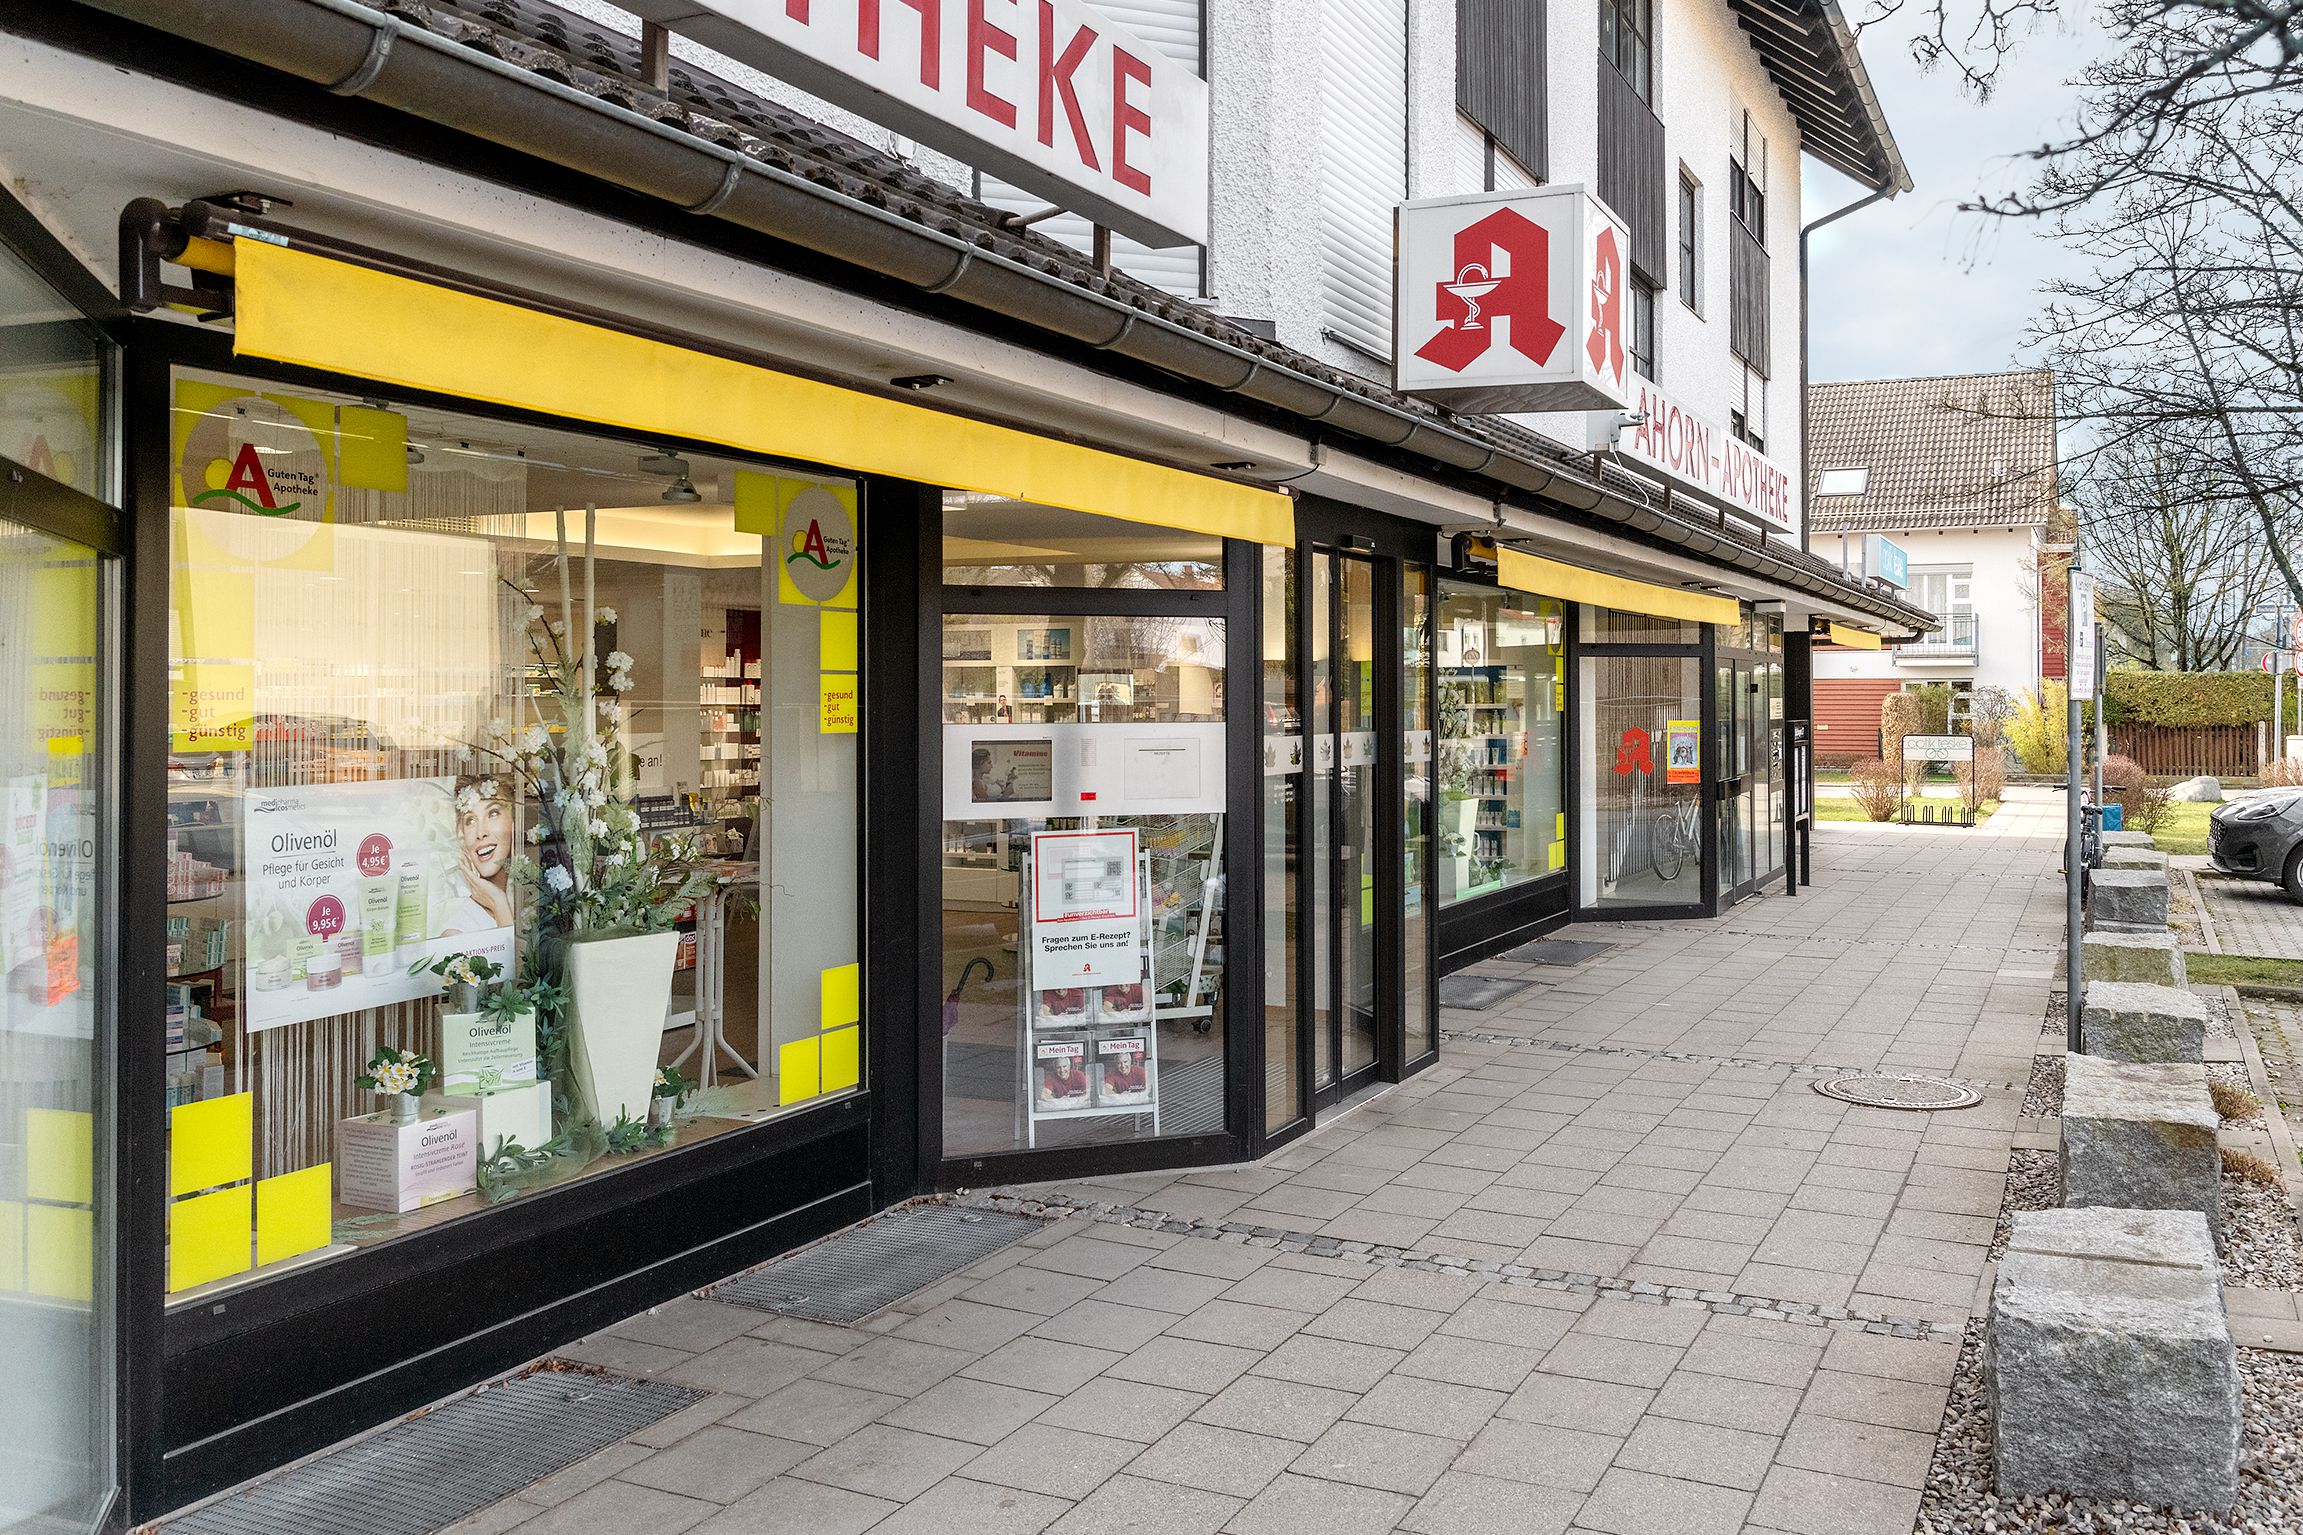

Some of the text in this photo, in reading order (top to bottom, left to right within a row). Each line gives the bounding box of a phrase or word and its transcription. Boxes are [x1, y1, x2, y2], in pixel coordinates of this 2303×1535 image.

[1635, 386, 1788, 523] AHORN-APOTHEKE
[267, 467, 296, 481] Guten
[273, 482, 318, 496] Apotheke
[823, 535, 838, 545] Guten
[826, 545, 849, 555] Apotheke
[271, 829, 337, 853] Olivenöl
[370, 844, 380, 854] Je
[263, 857, 344, 876] Pflege für Gesicht
[278, 874, 331, 890] und Körper
[321, 906, 331, 916] Je
[1042, 936, 1069, 945] Fragen
[1090, 931, 1131, 941] E-Rezept?
[1044, 940, 1129, 953] Sprechen Sie uns an!
[469, 1039, 511, 1048] Intensivcreme
[1048, 1045, 1079, 1054] Mein Tag
[1109, 1040, 1140, 1050] Mein Tag
[421, 1129, 457, 1147] Olivenöl
